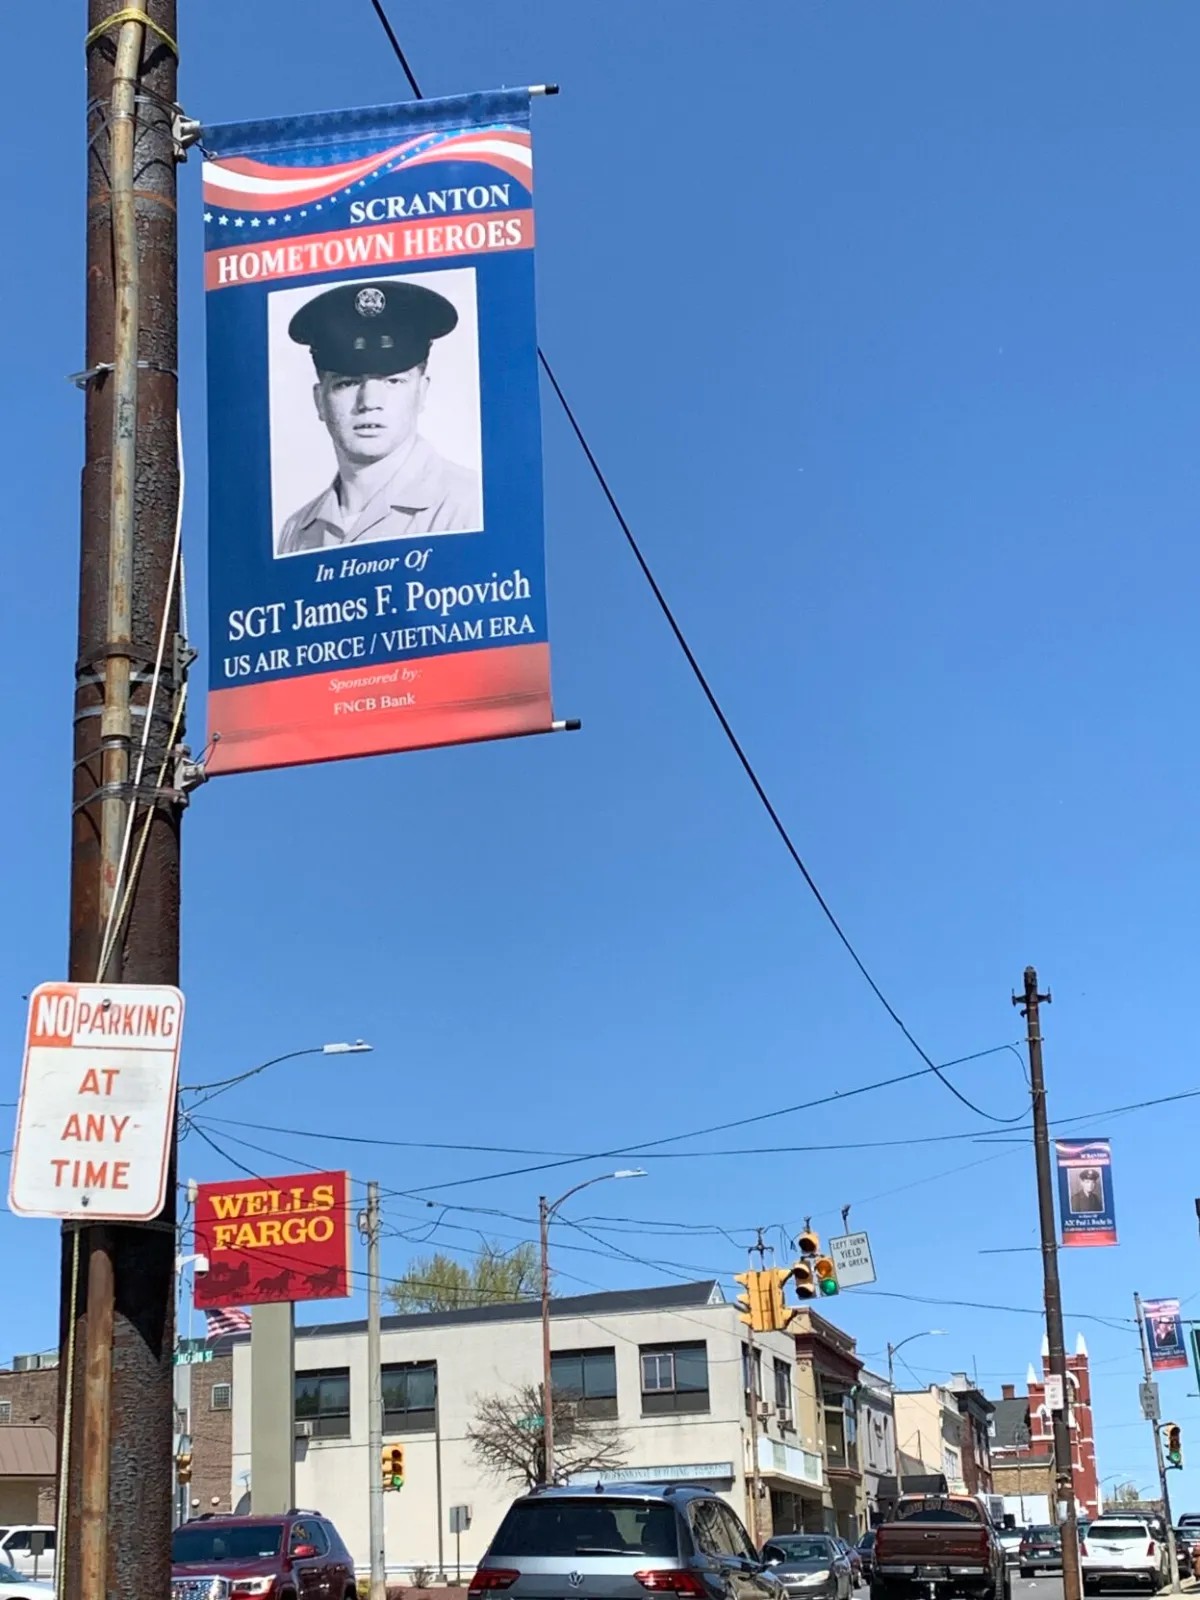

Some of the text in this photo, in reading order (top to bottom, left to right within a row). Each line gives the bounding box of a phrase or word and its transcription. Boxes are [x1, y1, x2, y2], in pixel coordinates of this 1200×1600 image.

[350, 184, 510, 224] SCRANTON
[217, 218, 522, 284] HOMETOWN HEROES
[315, 548, 433, 582] In Honor Of
[228, 569, 532, 641] SGT James F. Popovich
[224, 614, 536, 678] US AIR FORCE / VIETNAM ERA
[328, 670, 399, 693] Sponsored
[333, 692, 416, 716] FNCB Bank
[34, 994, 175, 1038] NO PARKING
[78, 1069, 120, 1096] AT
[61, 1114, 131, 1143] ANY
[50, 1159, 130, 1190] TIME
[208, 1184, 336, 1220] WELLS
[212, 1216, 336, 1251] FARGO
[832, 1237, 865, 1250] LEFT TURN
[840, 1247, 861, 1259] YIELD
[848, 1257, 869, 1267] GREEN
